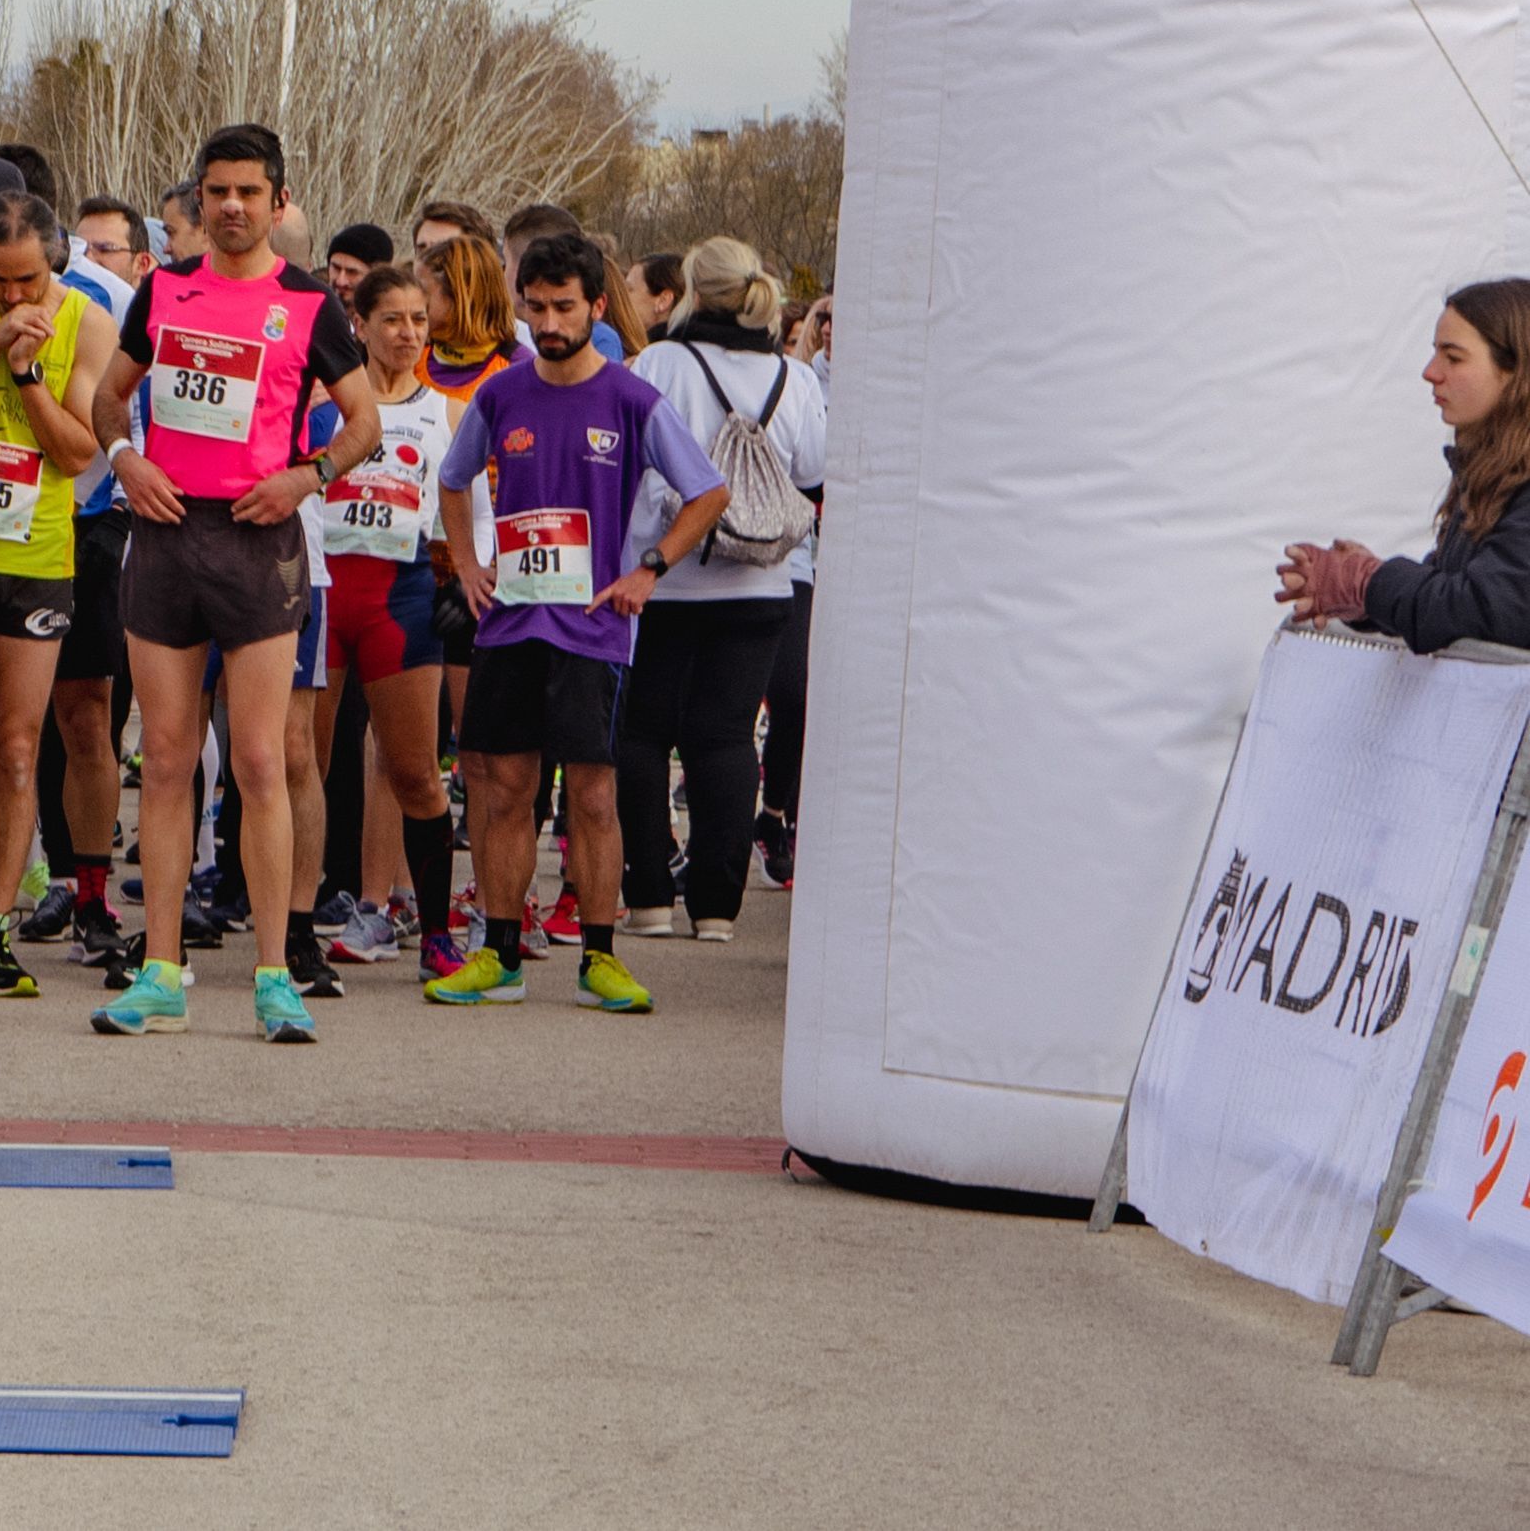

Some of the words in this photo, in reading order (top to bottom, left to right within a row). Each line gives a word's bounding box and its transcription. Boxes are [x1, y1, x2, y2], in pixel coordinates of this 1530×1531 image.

[174, 370, 227, 405] 336
[343, 502, 394, 529] 493
[518, 547, 561, 576] 491
